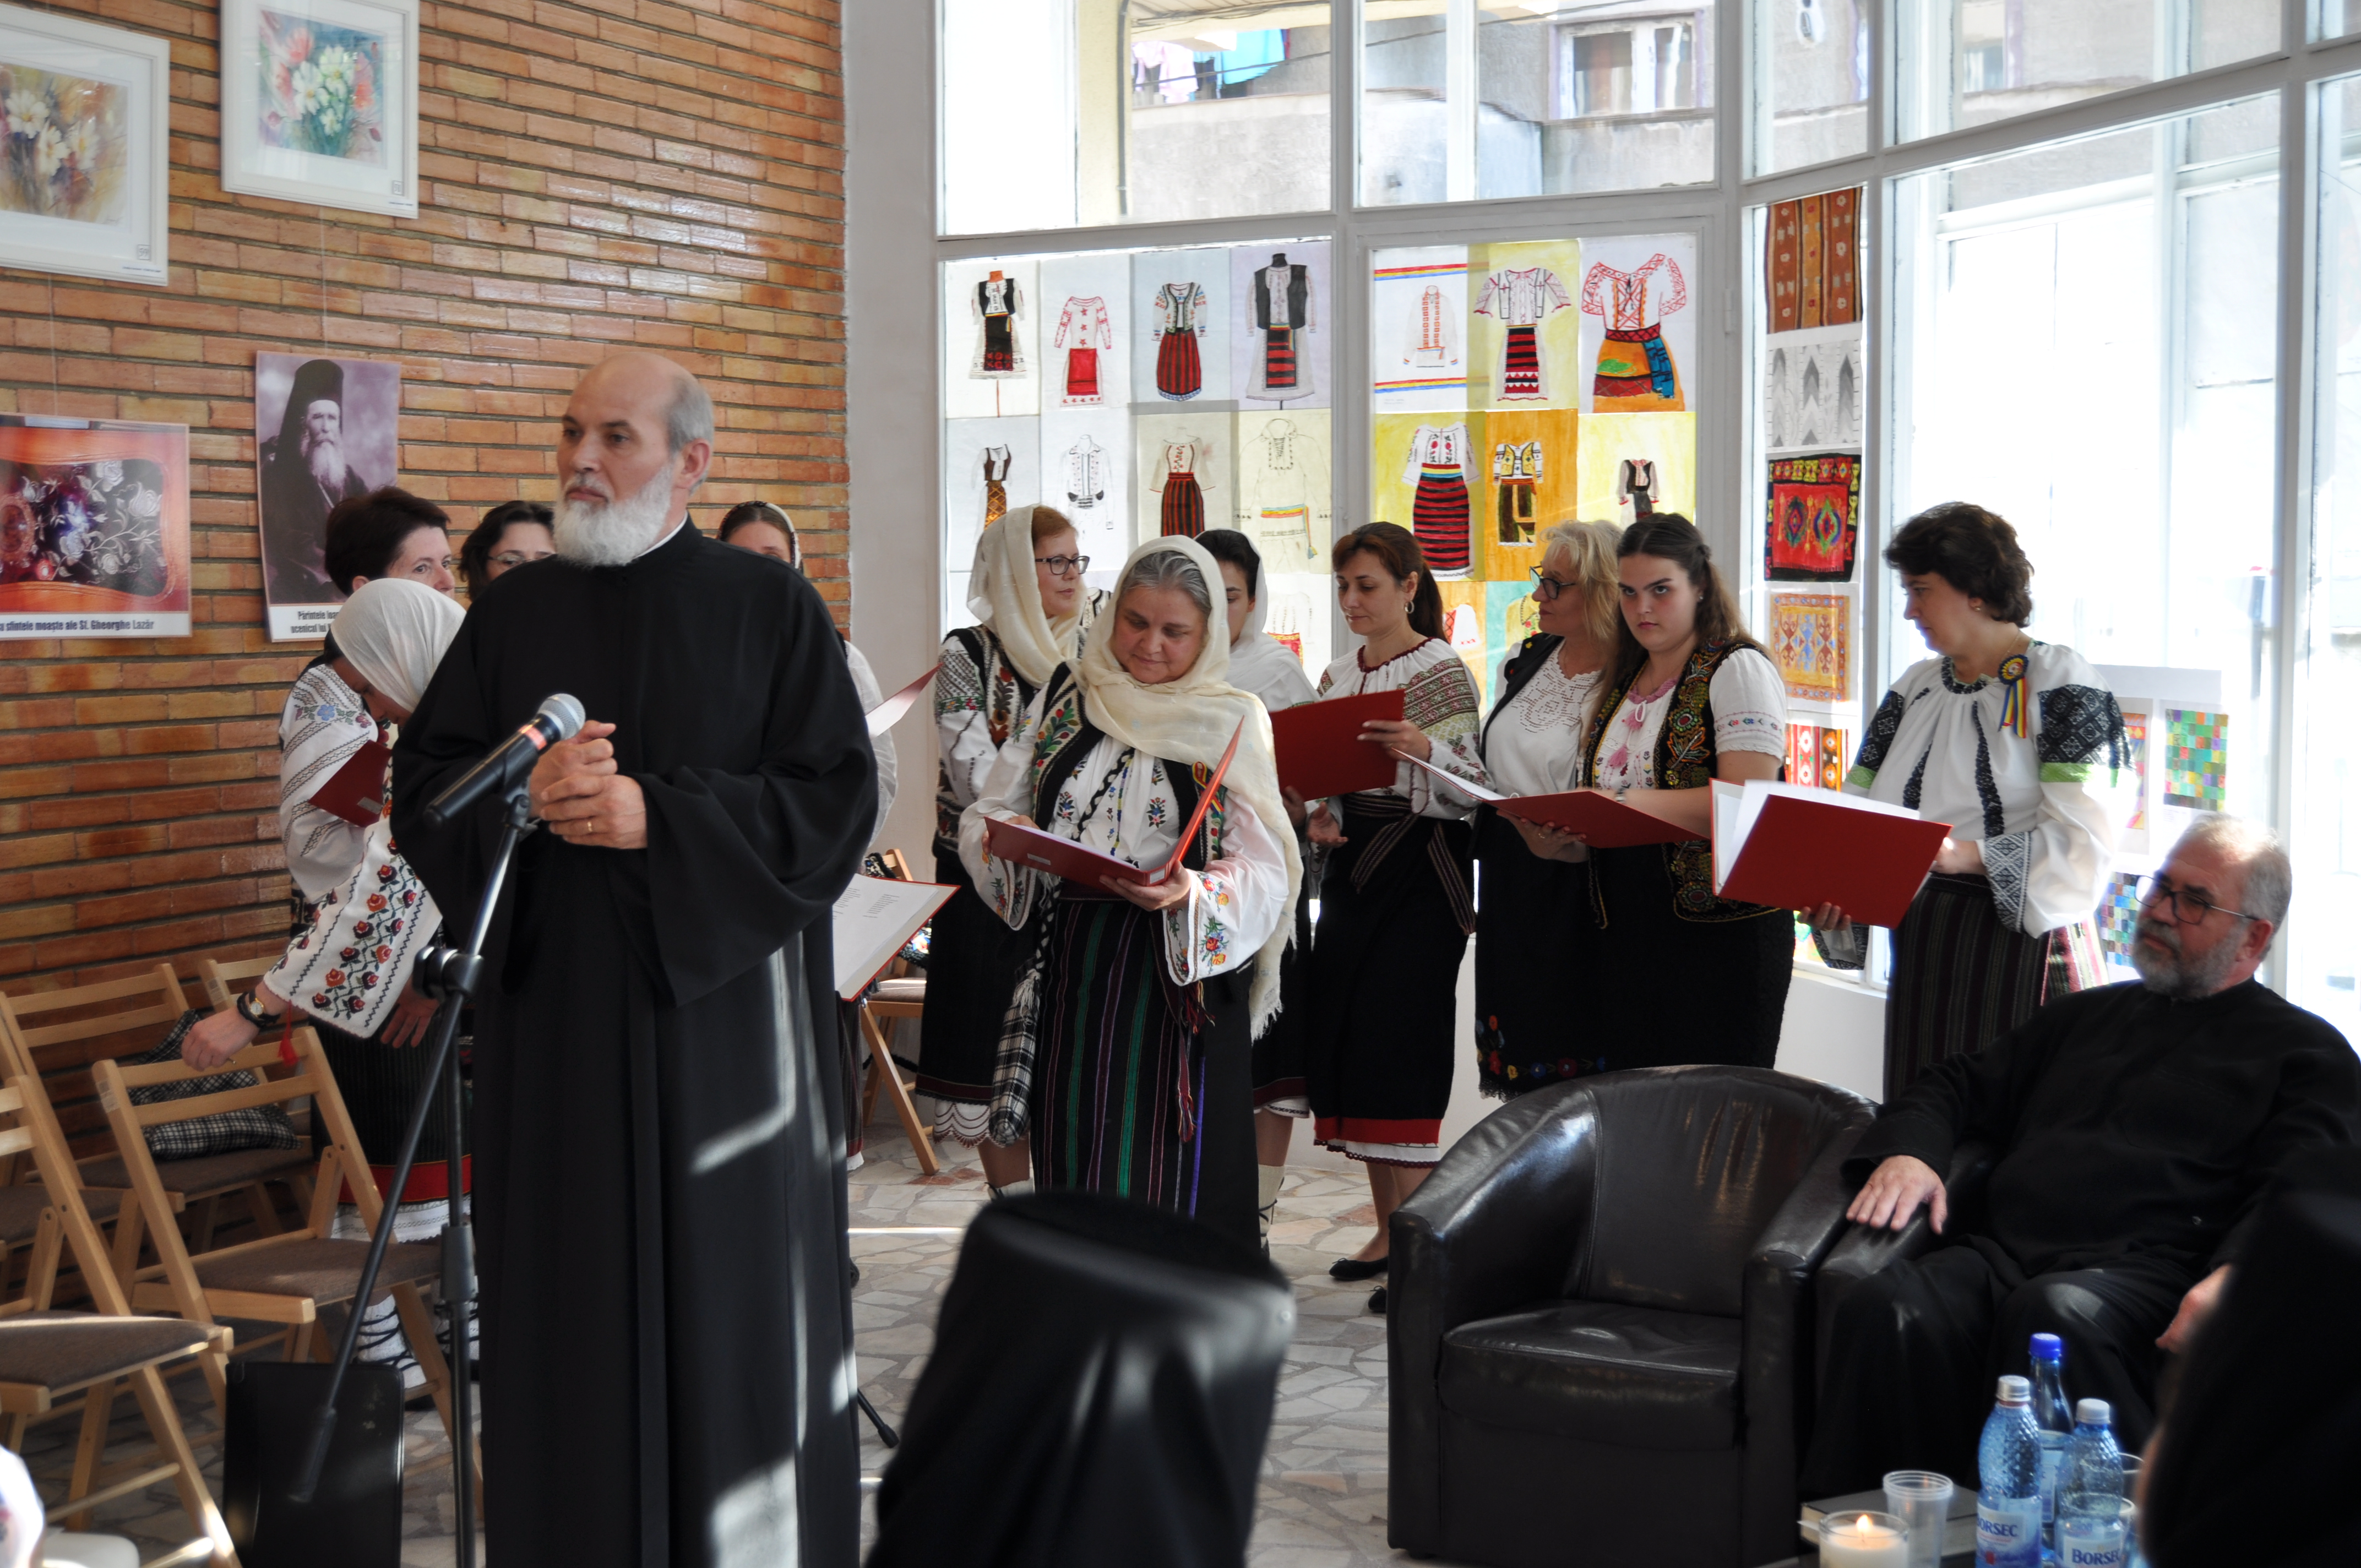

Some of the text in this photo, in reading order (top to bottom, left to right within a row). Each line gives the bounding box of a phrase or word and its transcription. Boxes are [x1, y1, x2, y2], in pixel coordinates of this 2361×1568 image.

[66, 620, 78, 630] ale
[91, 619, 130, 631] Gheorghe
[1976, 1518, 2019, 1537] ORSEC
